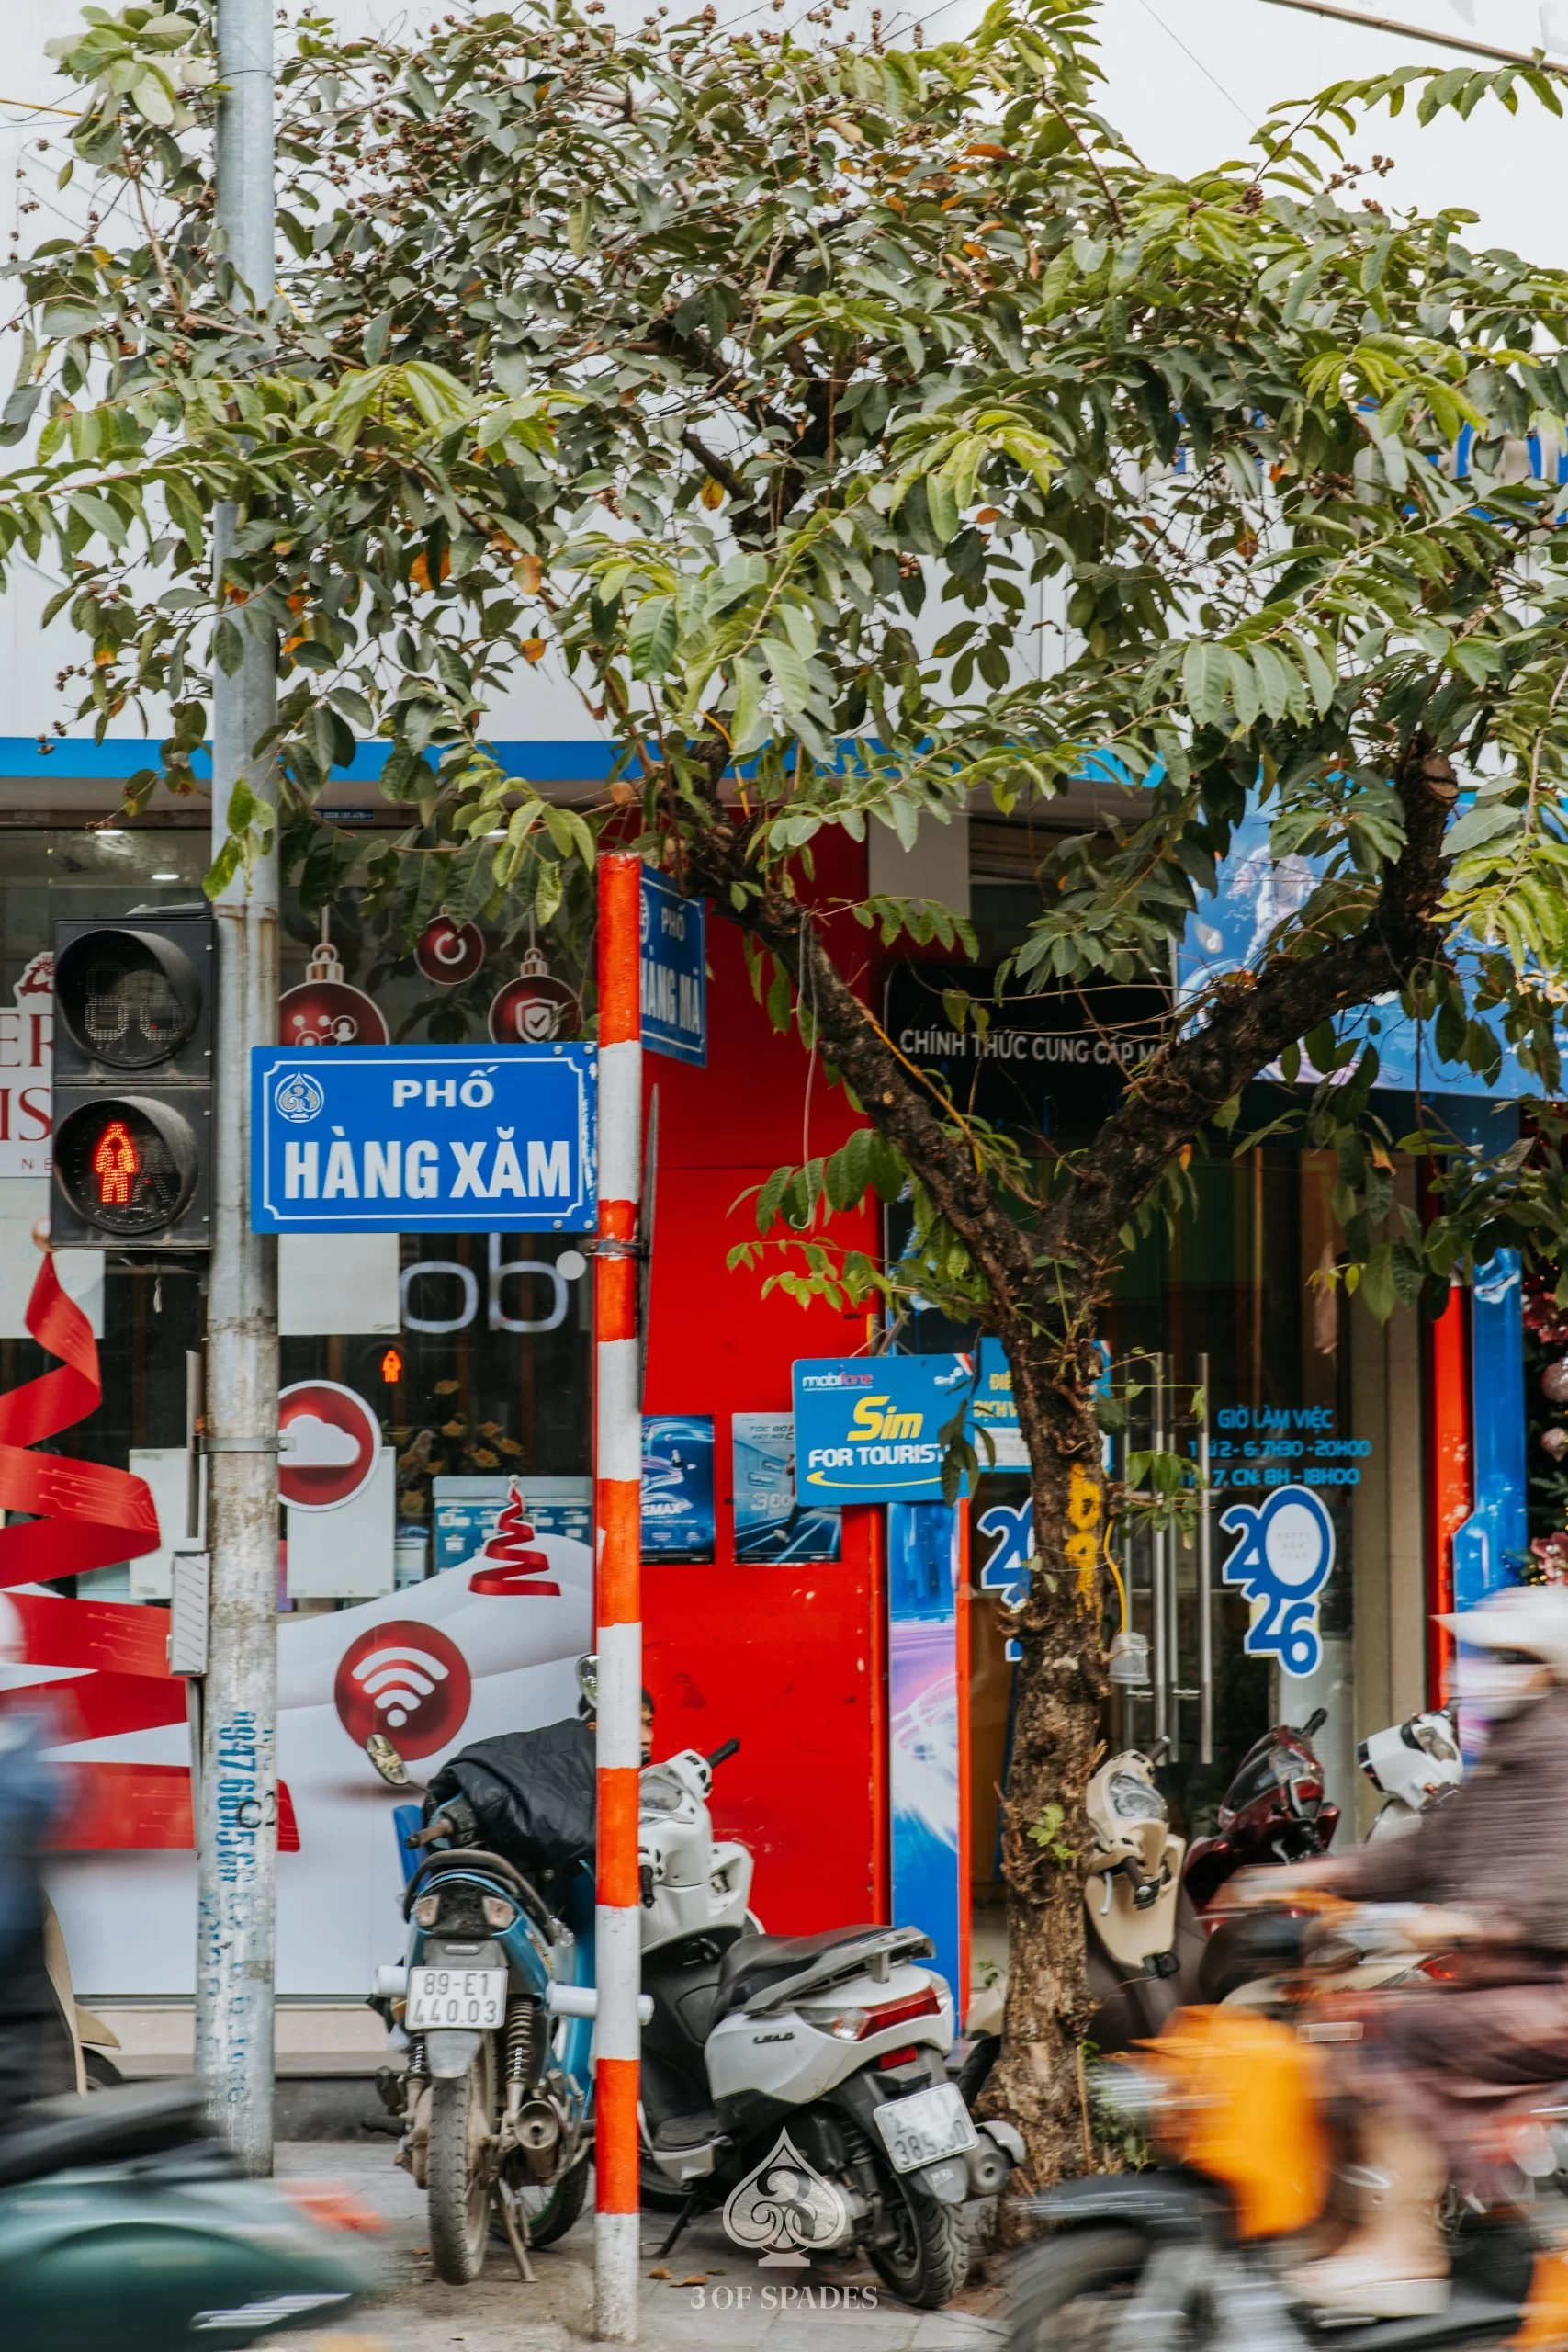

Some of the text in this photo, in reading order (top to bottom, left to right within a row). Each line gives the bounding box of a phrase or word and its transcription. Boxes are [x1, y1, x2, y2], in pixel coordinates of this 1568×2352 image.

[899, 1023, 964, 1056] CHÍNH
[1032, 1036, 1090, 1064] CUNG
[392, 1065, 500, 1108] PHỐ
[284, 1125, 570, 1200] HÀNG XĂM
[802, 1364, 874, 1388] mobifone
[846, 1395, 924, 1442] Sim
[1292, 1404, 1335, 1434] VIỆC
[808, 1448, 854, 1469] FOR
[1220, 1440, 1233, 1457] 2
[976, 1497, 1034, 1590] 2
[423, 1973, 491, 1996] 89-E1
[412, 1999, 498, 2024] 440.03
